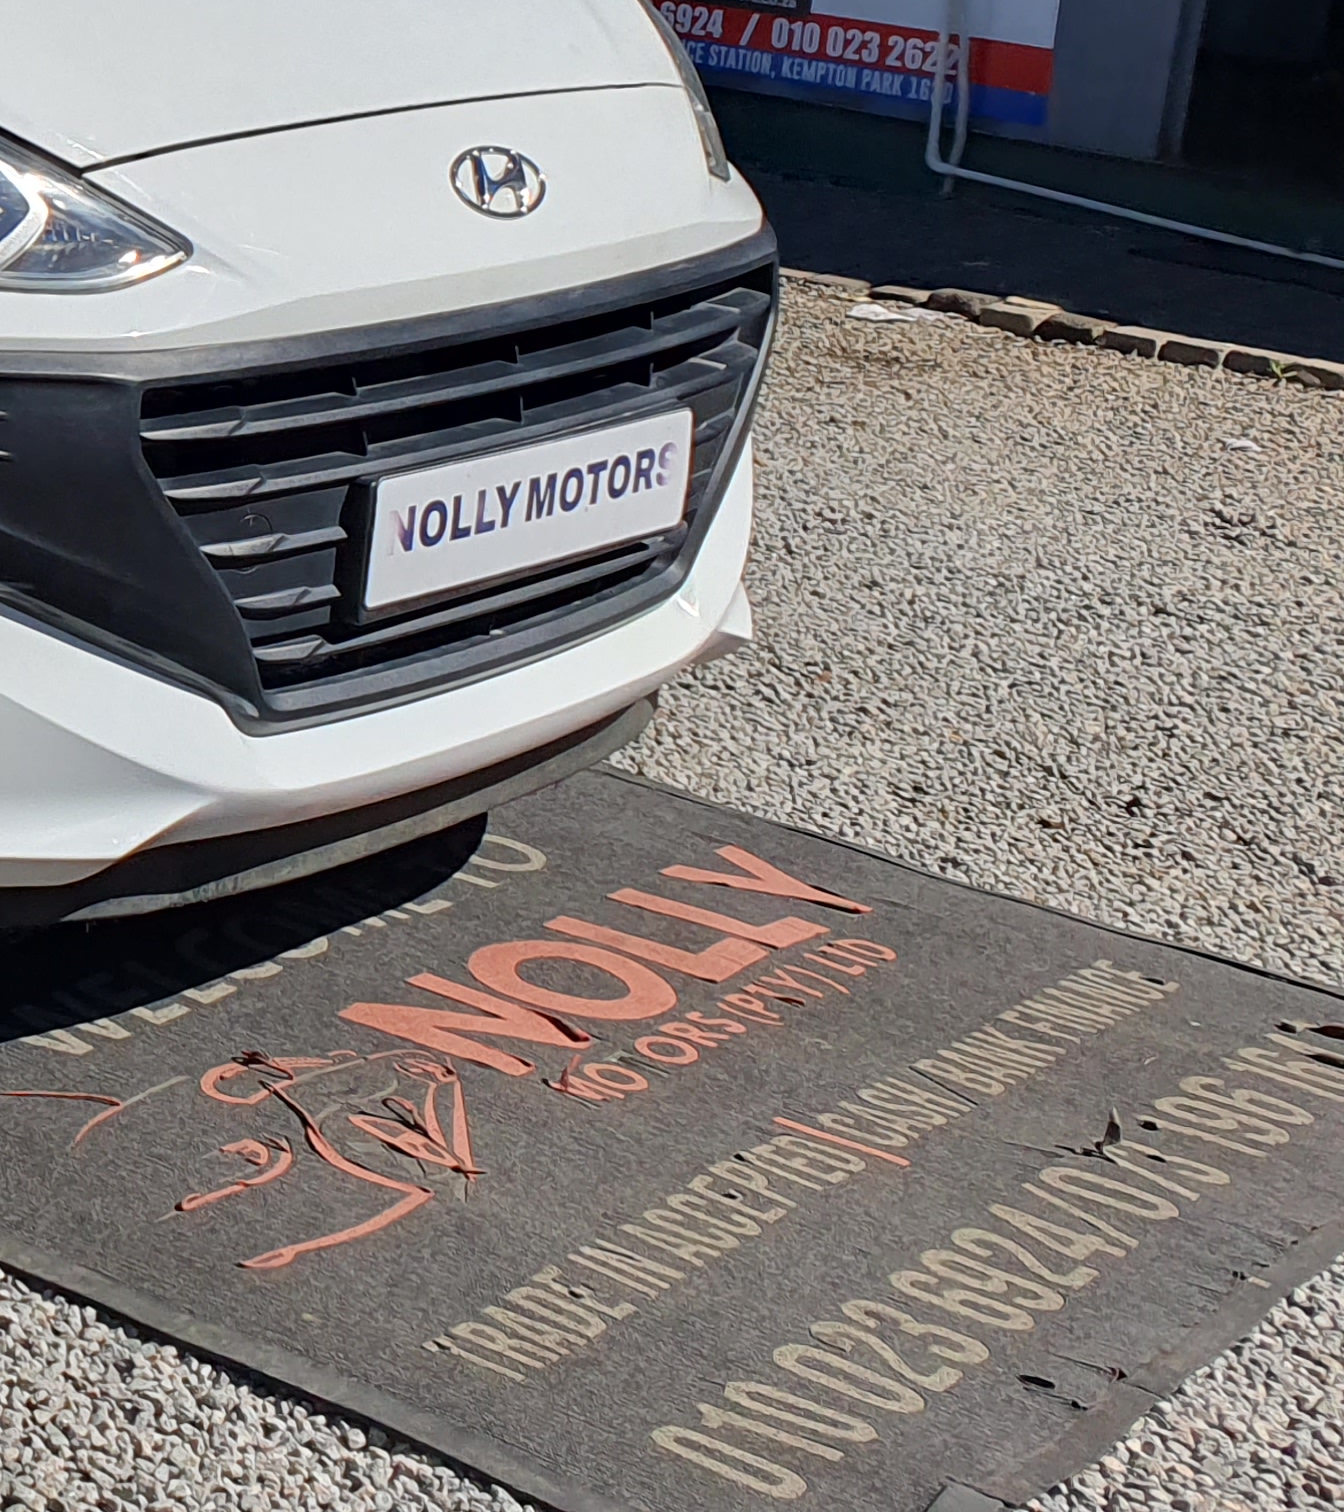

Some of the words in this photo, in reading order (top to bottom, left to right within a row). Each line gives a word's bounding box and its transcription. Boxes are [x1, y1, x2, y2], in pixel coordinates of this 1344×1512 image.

[708, 44, 777, 80] STATION,
[780, 55, 857, 90] KEMPTON
[861, 69, 905, 98] PARK
[770, 17, 821, 54] 010
[825, 26, 881, 63] 023
[386, 481, 522, 556] NOLLY
[524, 441, 680, 523] MOTORS
[336, 843, 875, 1078] NOLLY
[802, 938, 898, 977] LTD
[995, 958, 1181, 1045] FINANCE
[618, 1133, 868, 1268] ACCEPTED
[567, 1238, 687, 1299] IN
[650, 1380, 881, 1500] 010
[771, 1298, 991, 1414] 023
[1134, 1075, 1316, 1159] 196
[422, 1264, 638, 1384] TRADE
